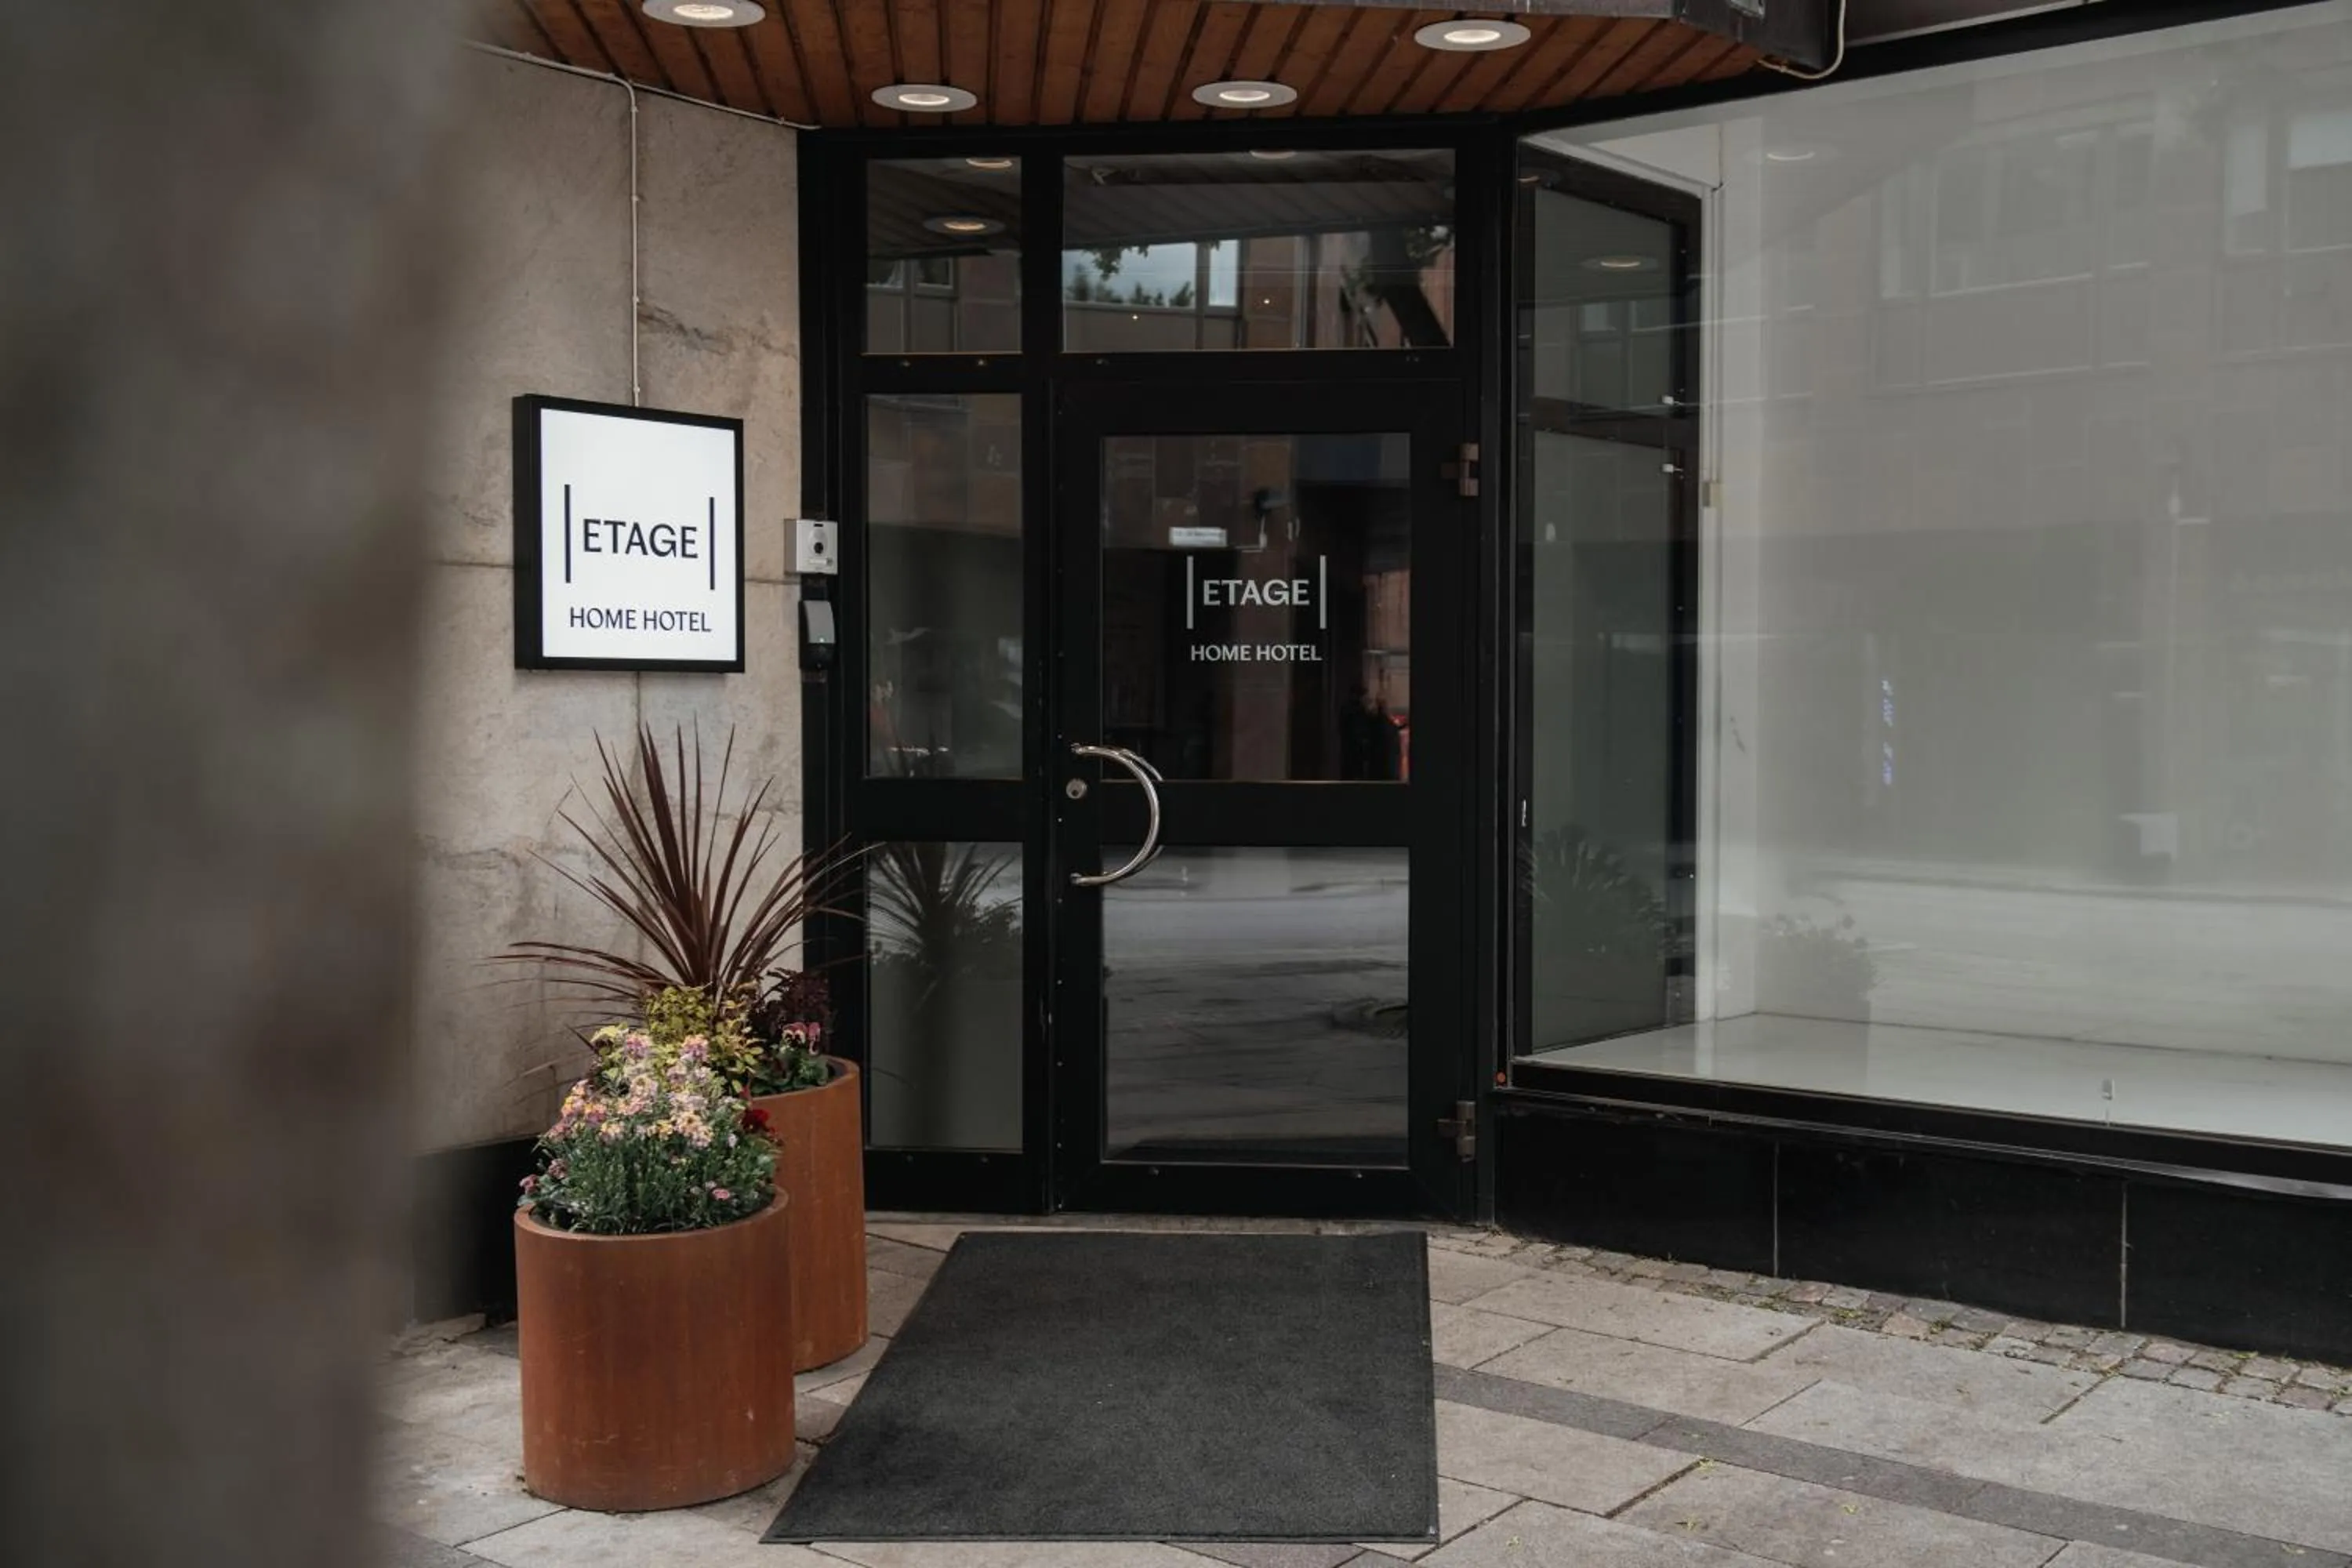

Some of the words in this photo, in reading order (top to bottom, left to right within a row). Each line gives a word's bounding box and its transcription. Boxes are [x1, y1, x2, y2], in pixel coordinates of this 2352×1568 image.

[583, 518, 698, 558] ETAGE
[1203, 579, 1310, 606] ETAGE
[570, 607, 637, 629] HOME
[644, 610, 712, 632] HOTEL
[1191, 644, 1251, 661] HOME
[1256, 644, 1323, 661] HOTEL
